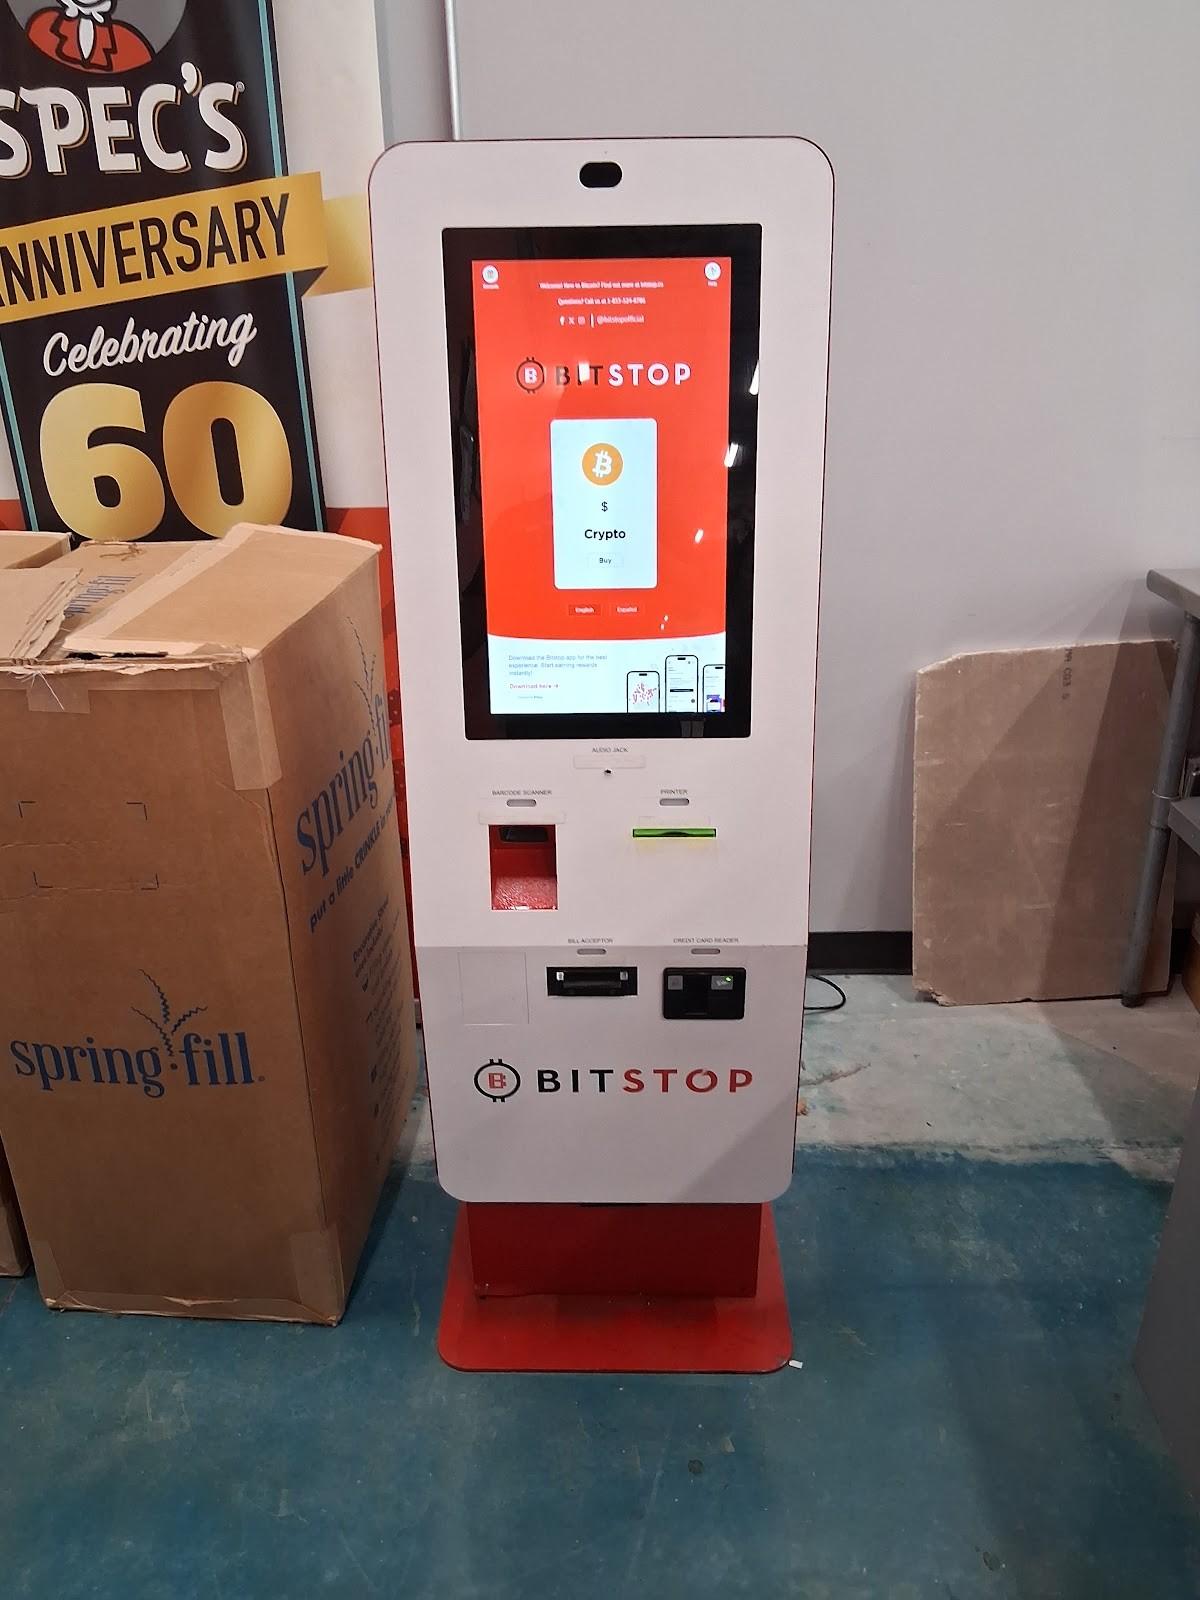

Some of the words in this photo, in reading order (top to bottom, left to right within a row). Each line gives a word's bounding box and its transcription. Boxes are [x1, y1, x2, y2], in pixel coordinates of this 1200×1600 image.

[0, 193, 290, 309] NNIVERSARY
[43, 311, 257, 377] Celebrating
[555, 362, 691, 387] BITSTOP
[39, 381, 293, 542] 60
[584, 529, 626, 541] Crypto
[599, 557, 612, 565] Buy
[492, 788, 521, 796] BARCODE
[522, 788, 552, 796] SCANNER
[660, 788, 688, 796] PRINTER
[310, 899, 328, 933] put
[537, 1068, 753, 1093] BITSTOP
